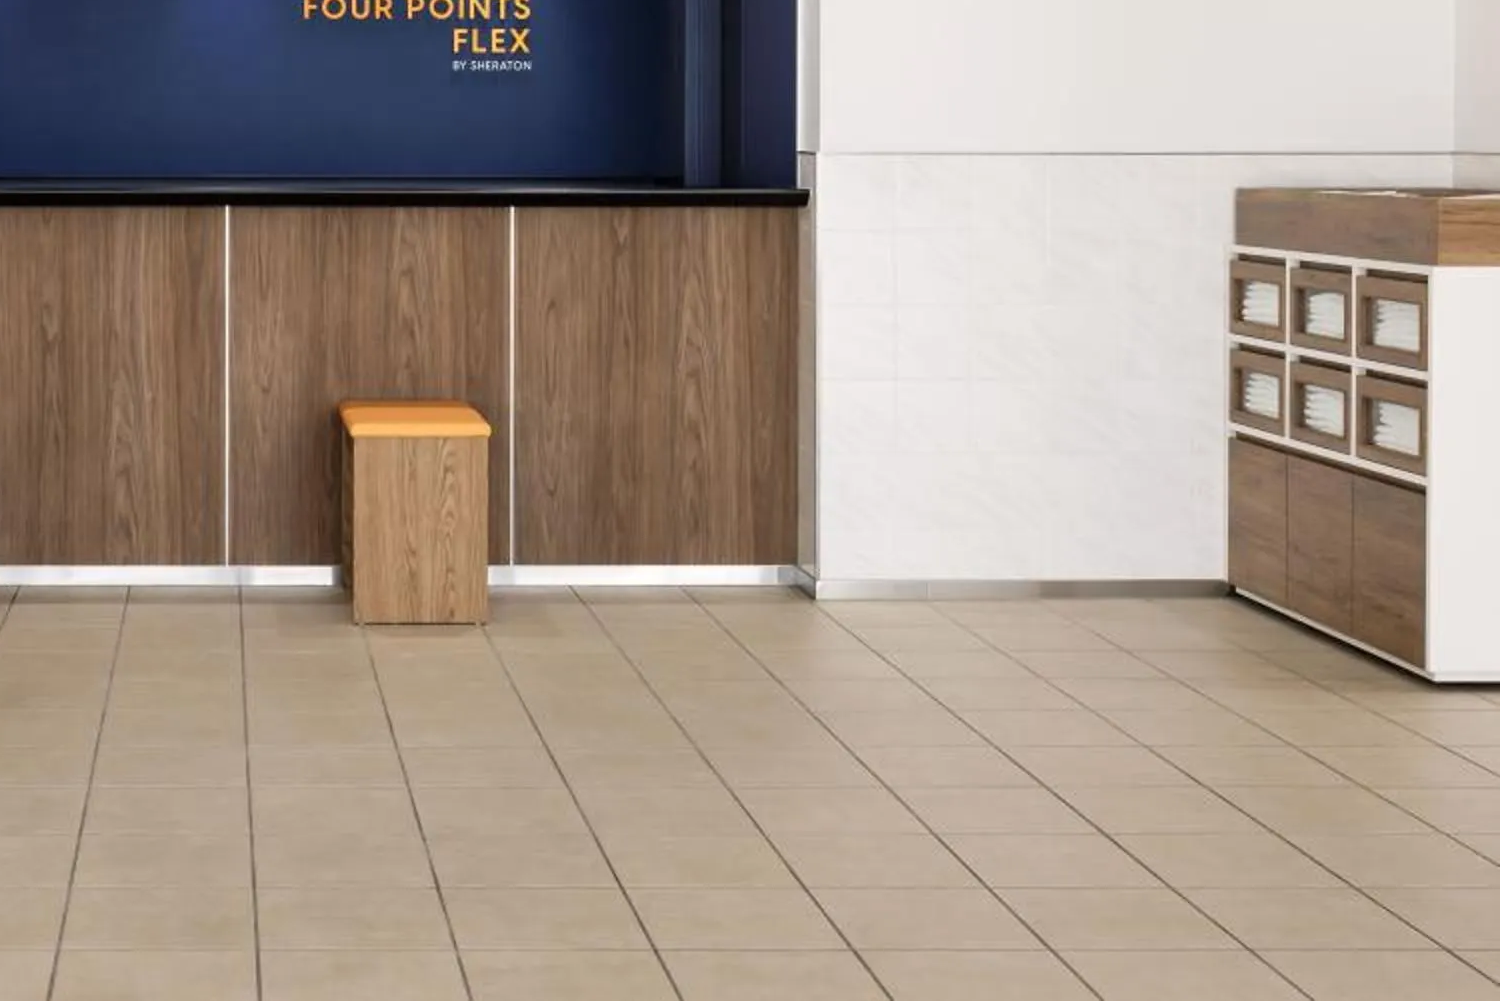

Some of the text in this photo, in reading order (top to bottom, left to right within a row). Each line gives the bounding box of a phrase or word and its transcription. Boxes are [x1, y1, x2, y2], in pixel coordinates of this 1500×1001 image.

[453, 28, 531, 54] FLEX
[452, 60, 533, 72] BY SHERATON
